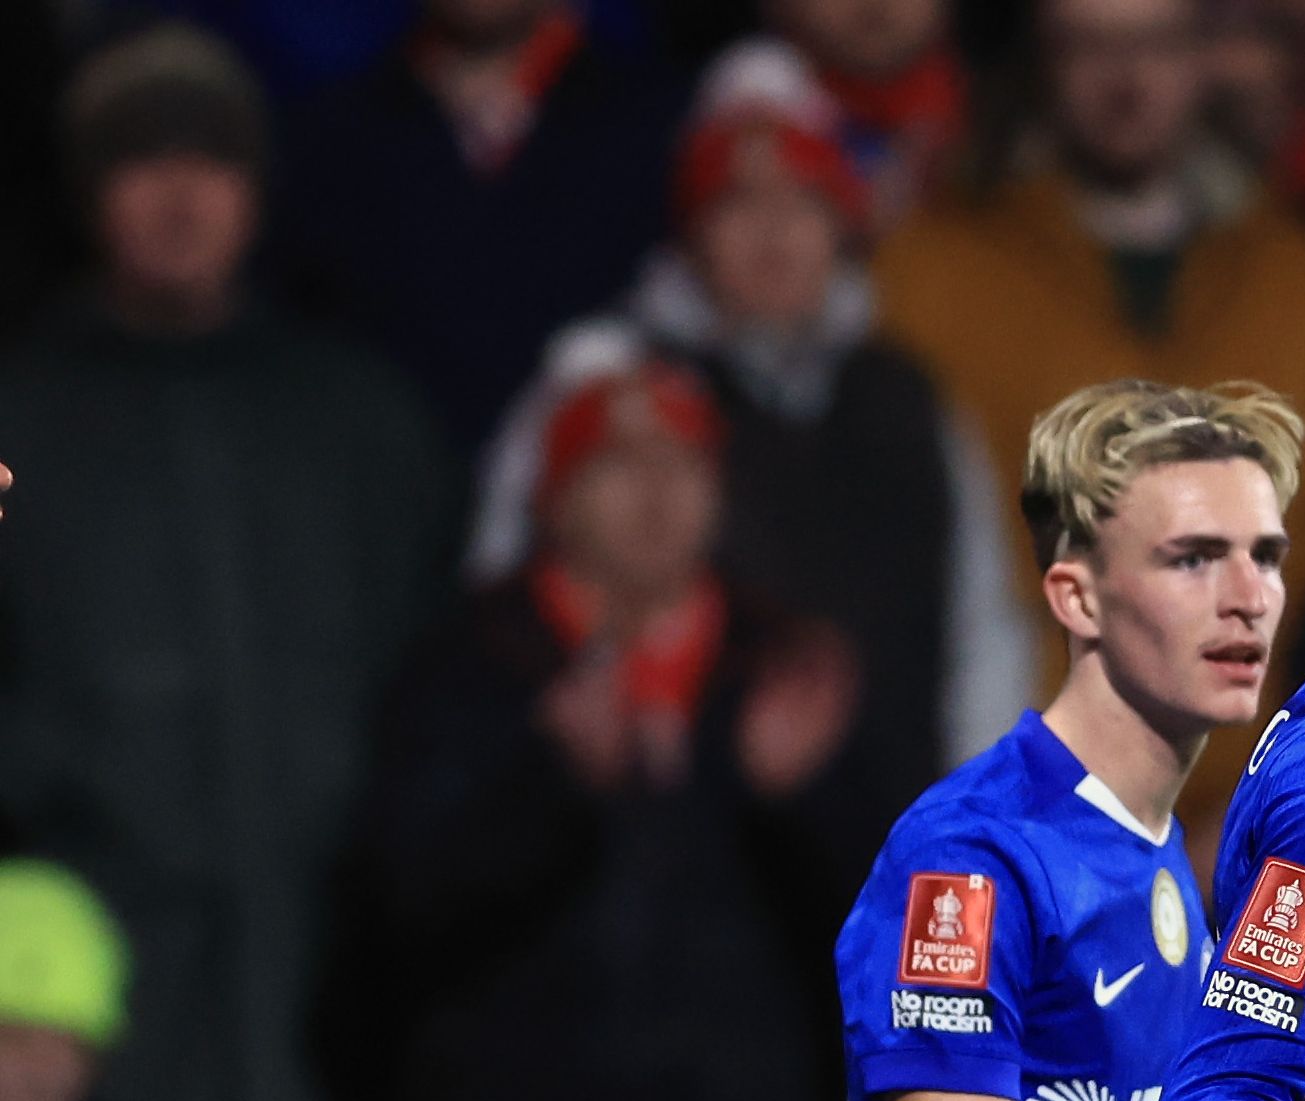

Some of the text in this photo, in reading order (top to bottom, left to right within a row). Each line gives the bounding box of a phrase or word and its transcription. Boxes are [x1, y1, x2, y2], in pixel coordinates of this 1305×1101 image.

[914, 939, 976, 958] Emirates
[1238, 938, 1299, 968] FA CUP
[1245, 924, 1303, 955] Emirates
[912, 955, 976, 973] FA CUP
[891, 989, 984, 1015] No room
[1210, 970, 1295, 1013] No room
[923, 1012, 992, 1033] racism
[1228, 995, 1298, 1033] racism
